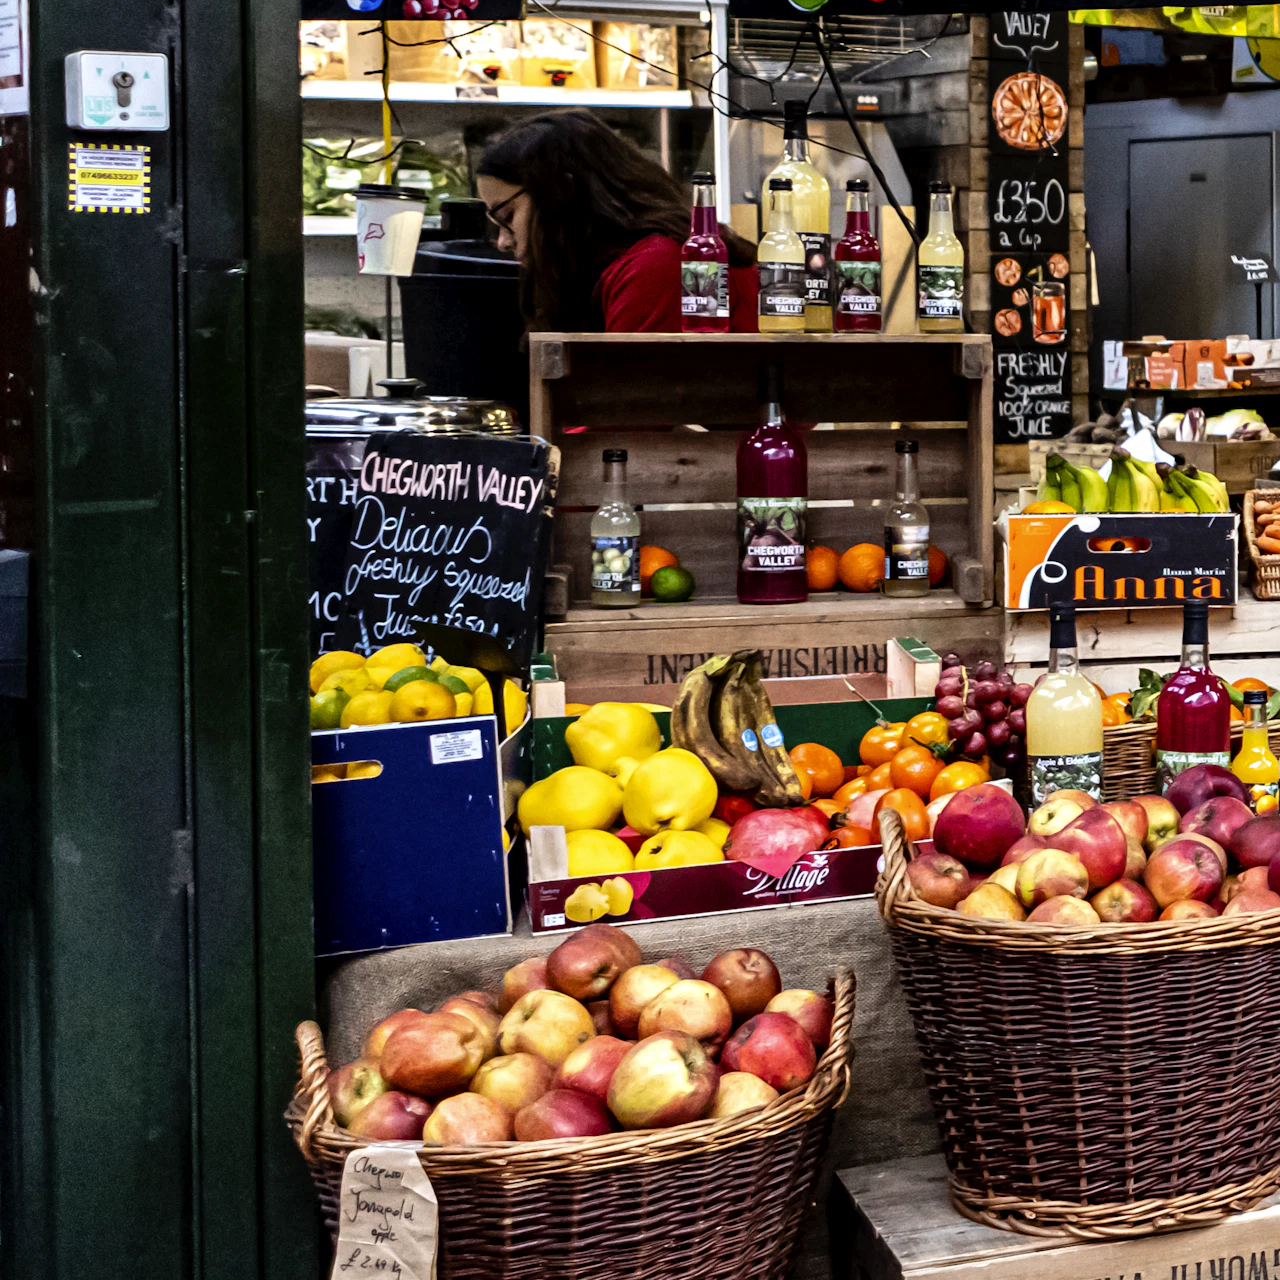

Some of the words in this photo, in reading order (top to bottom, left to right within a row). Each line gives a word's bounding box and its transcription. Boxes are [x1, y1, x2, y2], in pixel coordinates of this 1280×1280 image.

[997, 352, 1067, 379] FRESHLY
[1007, 415, 1053, 438] JUICE
[360, 451, 472, 501] CHEGWORTH
[477, 464, 543, 513] VALLEY
[748, 545, 805, 556] CHEGWORTH
[758, 556, 796, 567] VALLEY
[1073, 565, 1226, 601] Anna
[1163, 568, 1192, 576] Anna
[1194, 567, 1226, 576] Maria
[1036, 757, 1056, 769] Apple
[1058, 758, 1064, 766] &
[354, 1156, 404, 1190] Chegwo
